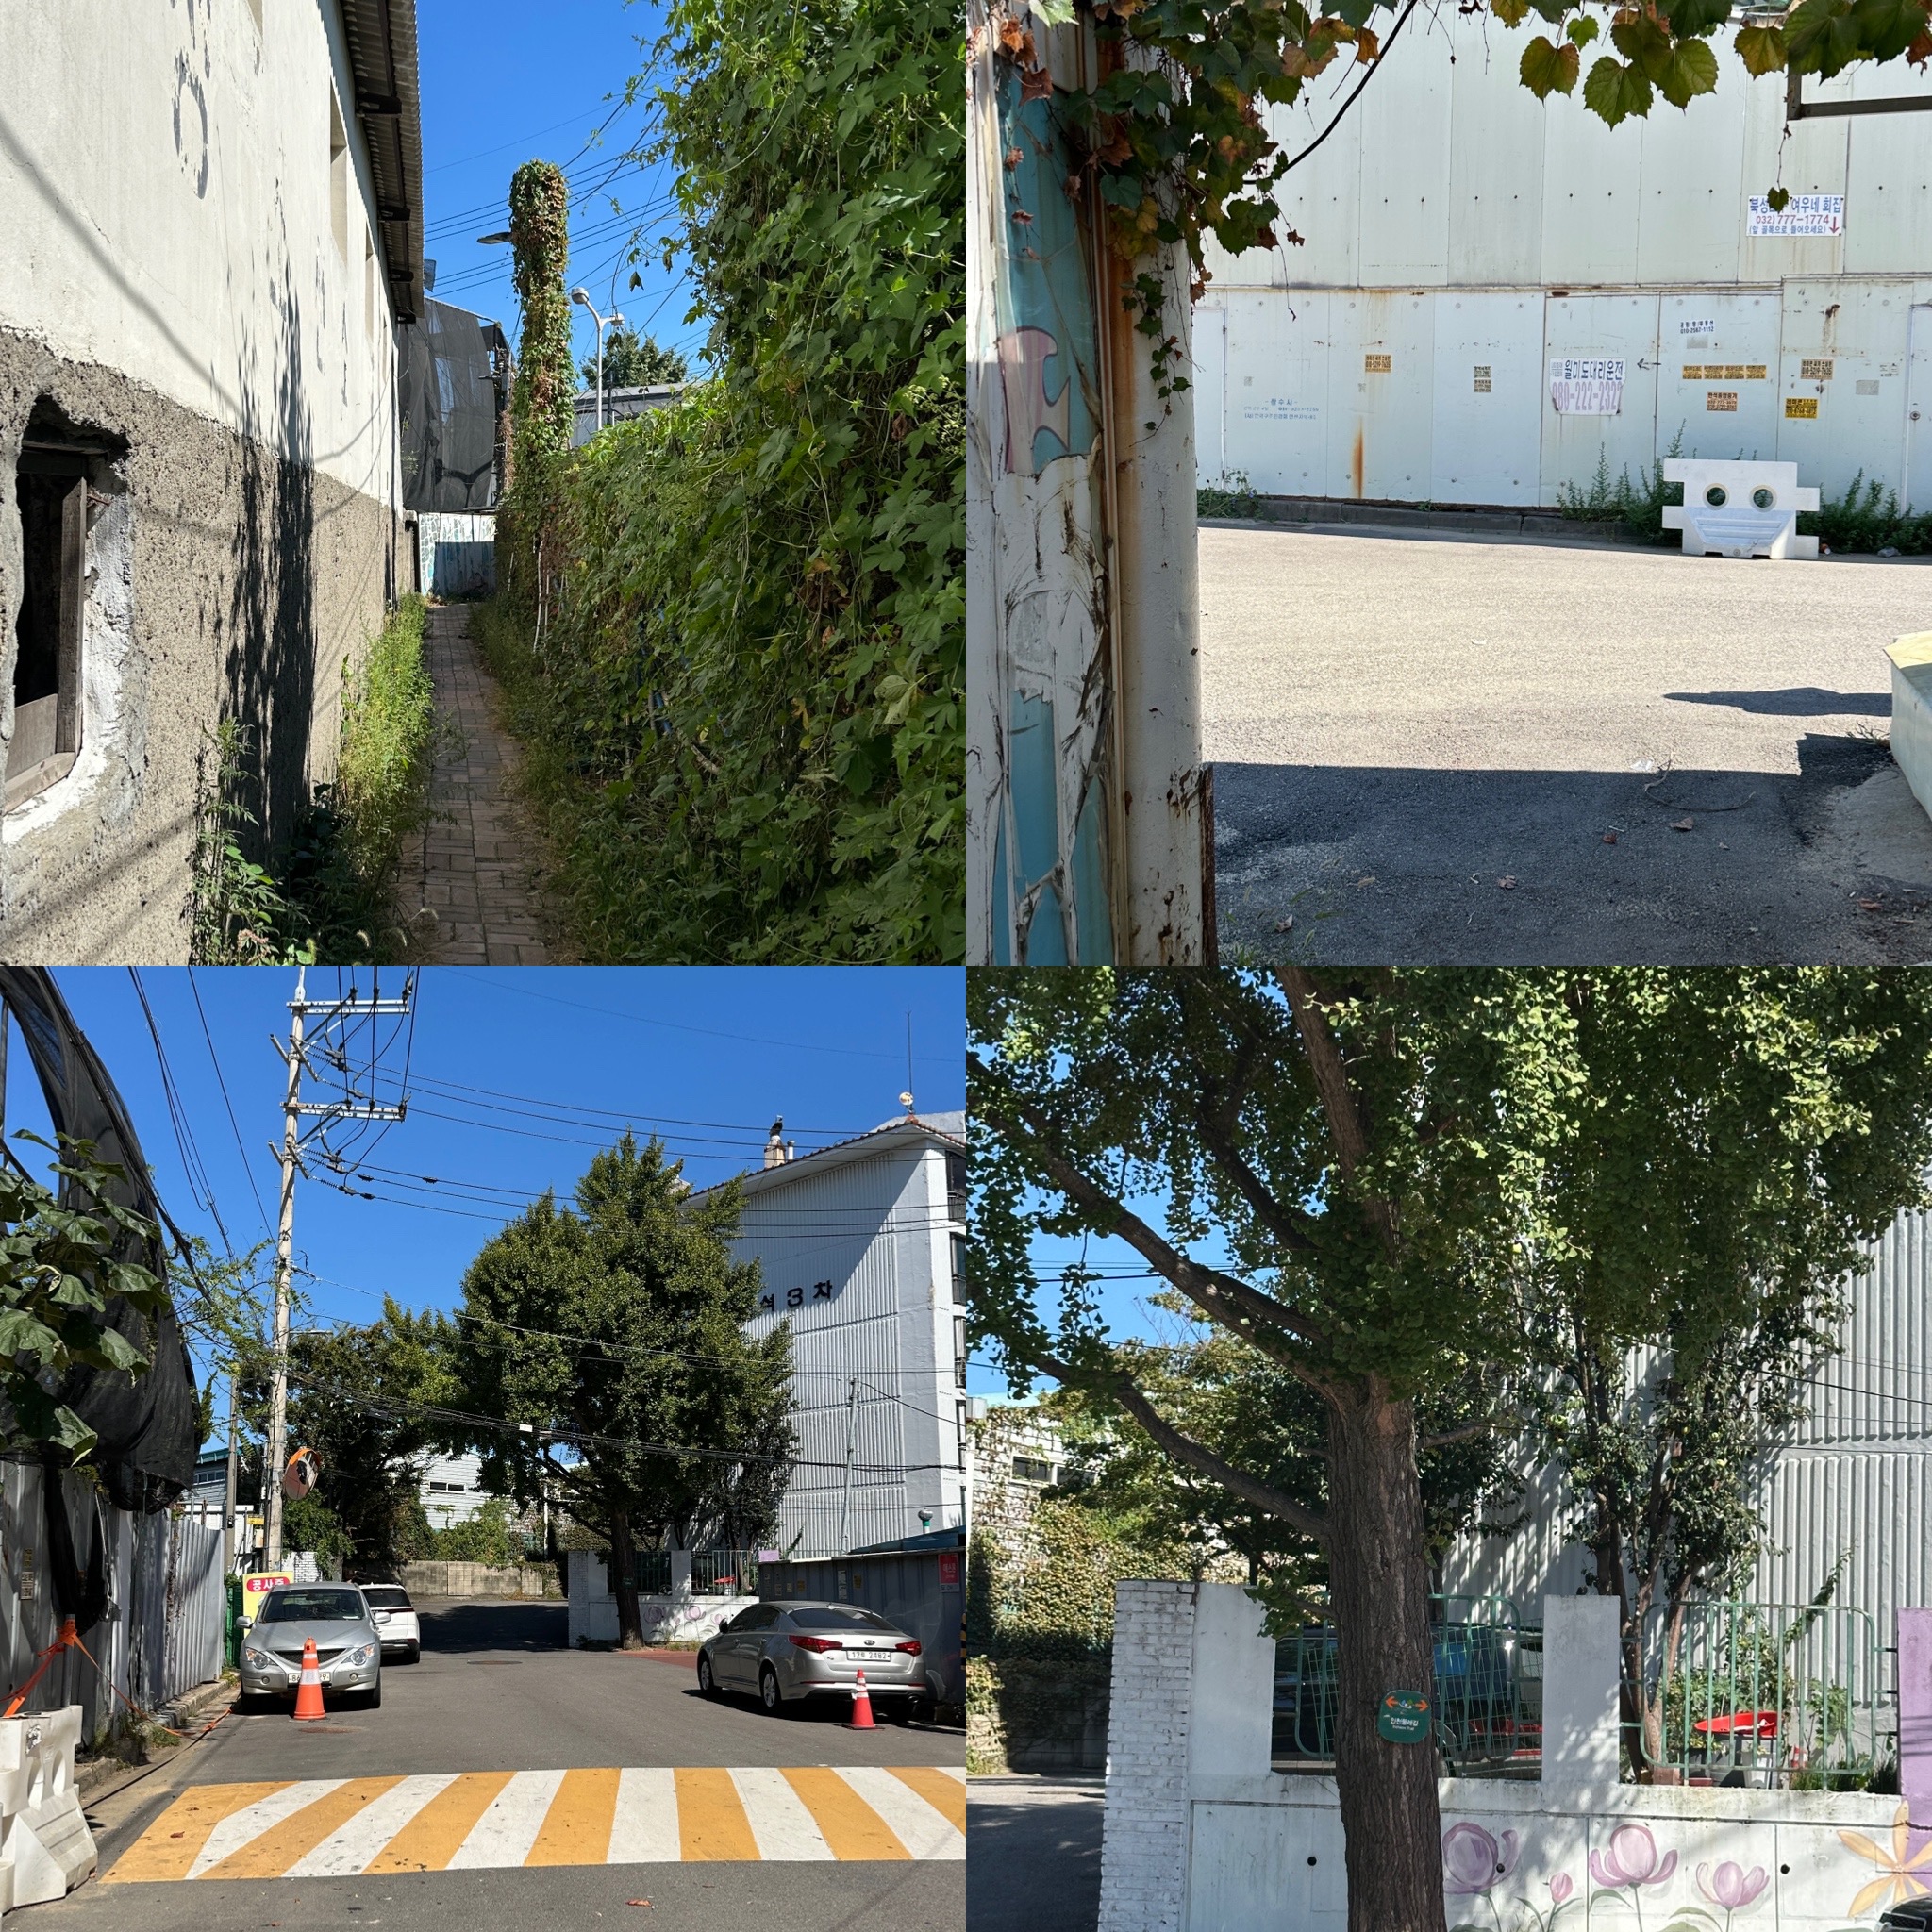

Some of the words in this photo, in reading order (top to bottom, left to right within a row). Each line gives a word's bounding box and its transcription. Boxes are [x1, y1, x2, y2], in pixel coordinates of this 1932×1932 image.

[1750, 196, 1789, 213] 북성
[1791, 196, 1819, 213] 여우네
[1822, 196, 1841, 213] 회집
[1762, 225, 1788, 235] 골목으로
[1790, 225, 1826, 235] 들어오세요)
[1564, 359, 1624, 380] 월미도대리운전
